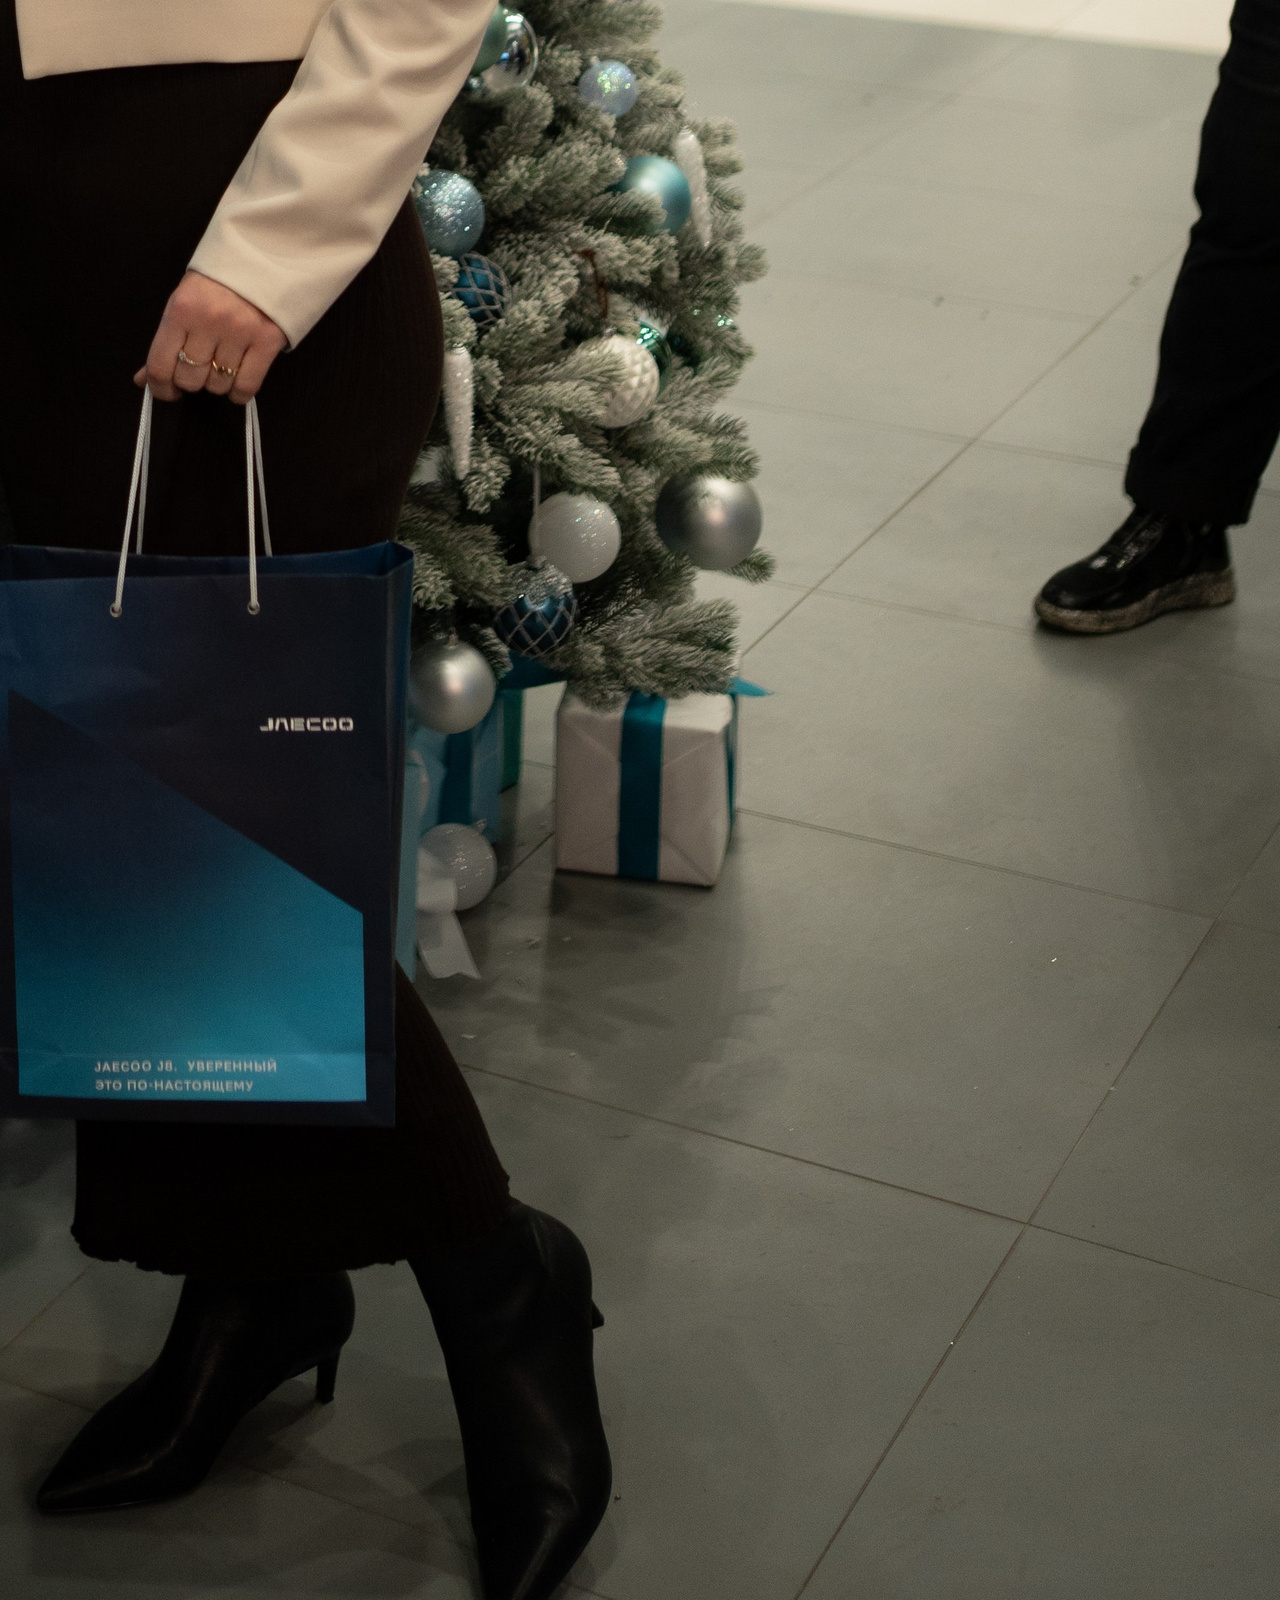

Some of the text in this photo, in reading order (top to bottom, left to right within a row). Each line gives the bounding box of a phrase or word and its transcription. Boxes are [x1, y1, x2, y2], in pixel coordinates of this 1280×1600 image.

[260, 717, 354, 732] JAECOO
[94, 1060, 152, 1073] JAECOO
[187, 1057, 277, 1072] УВЕРЕННЫЙ
[95, 1079, 254, 1093] ЭТО ПО-НАСТОЯЩЕМУ
